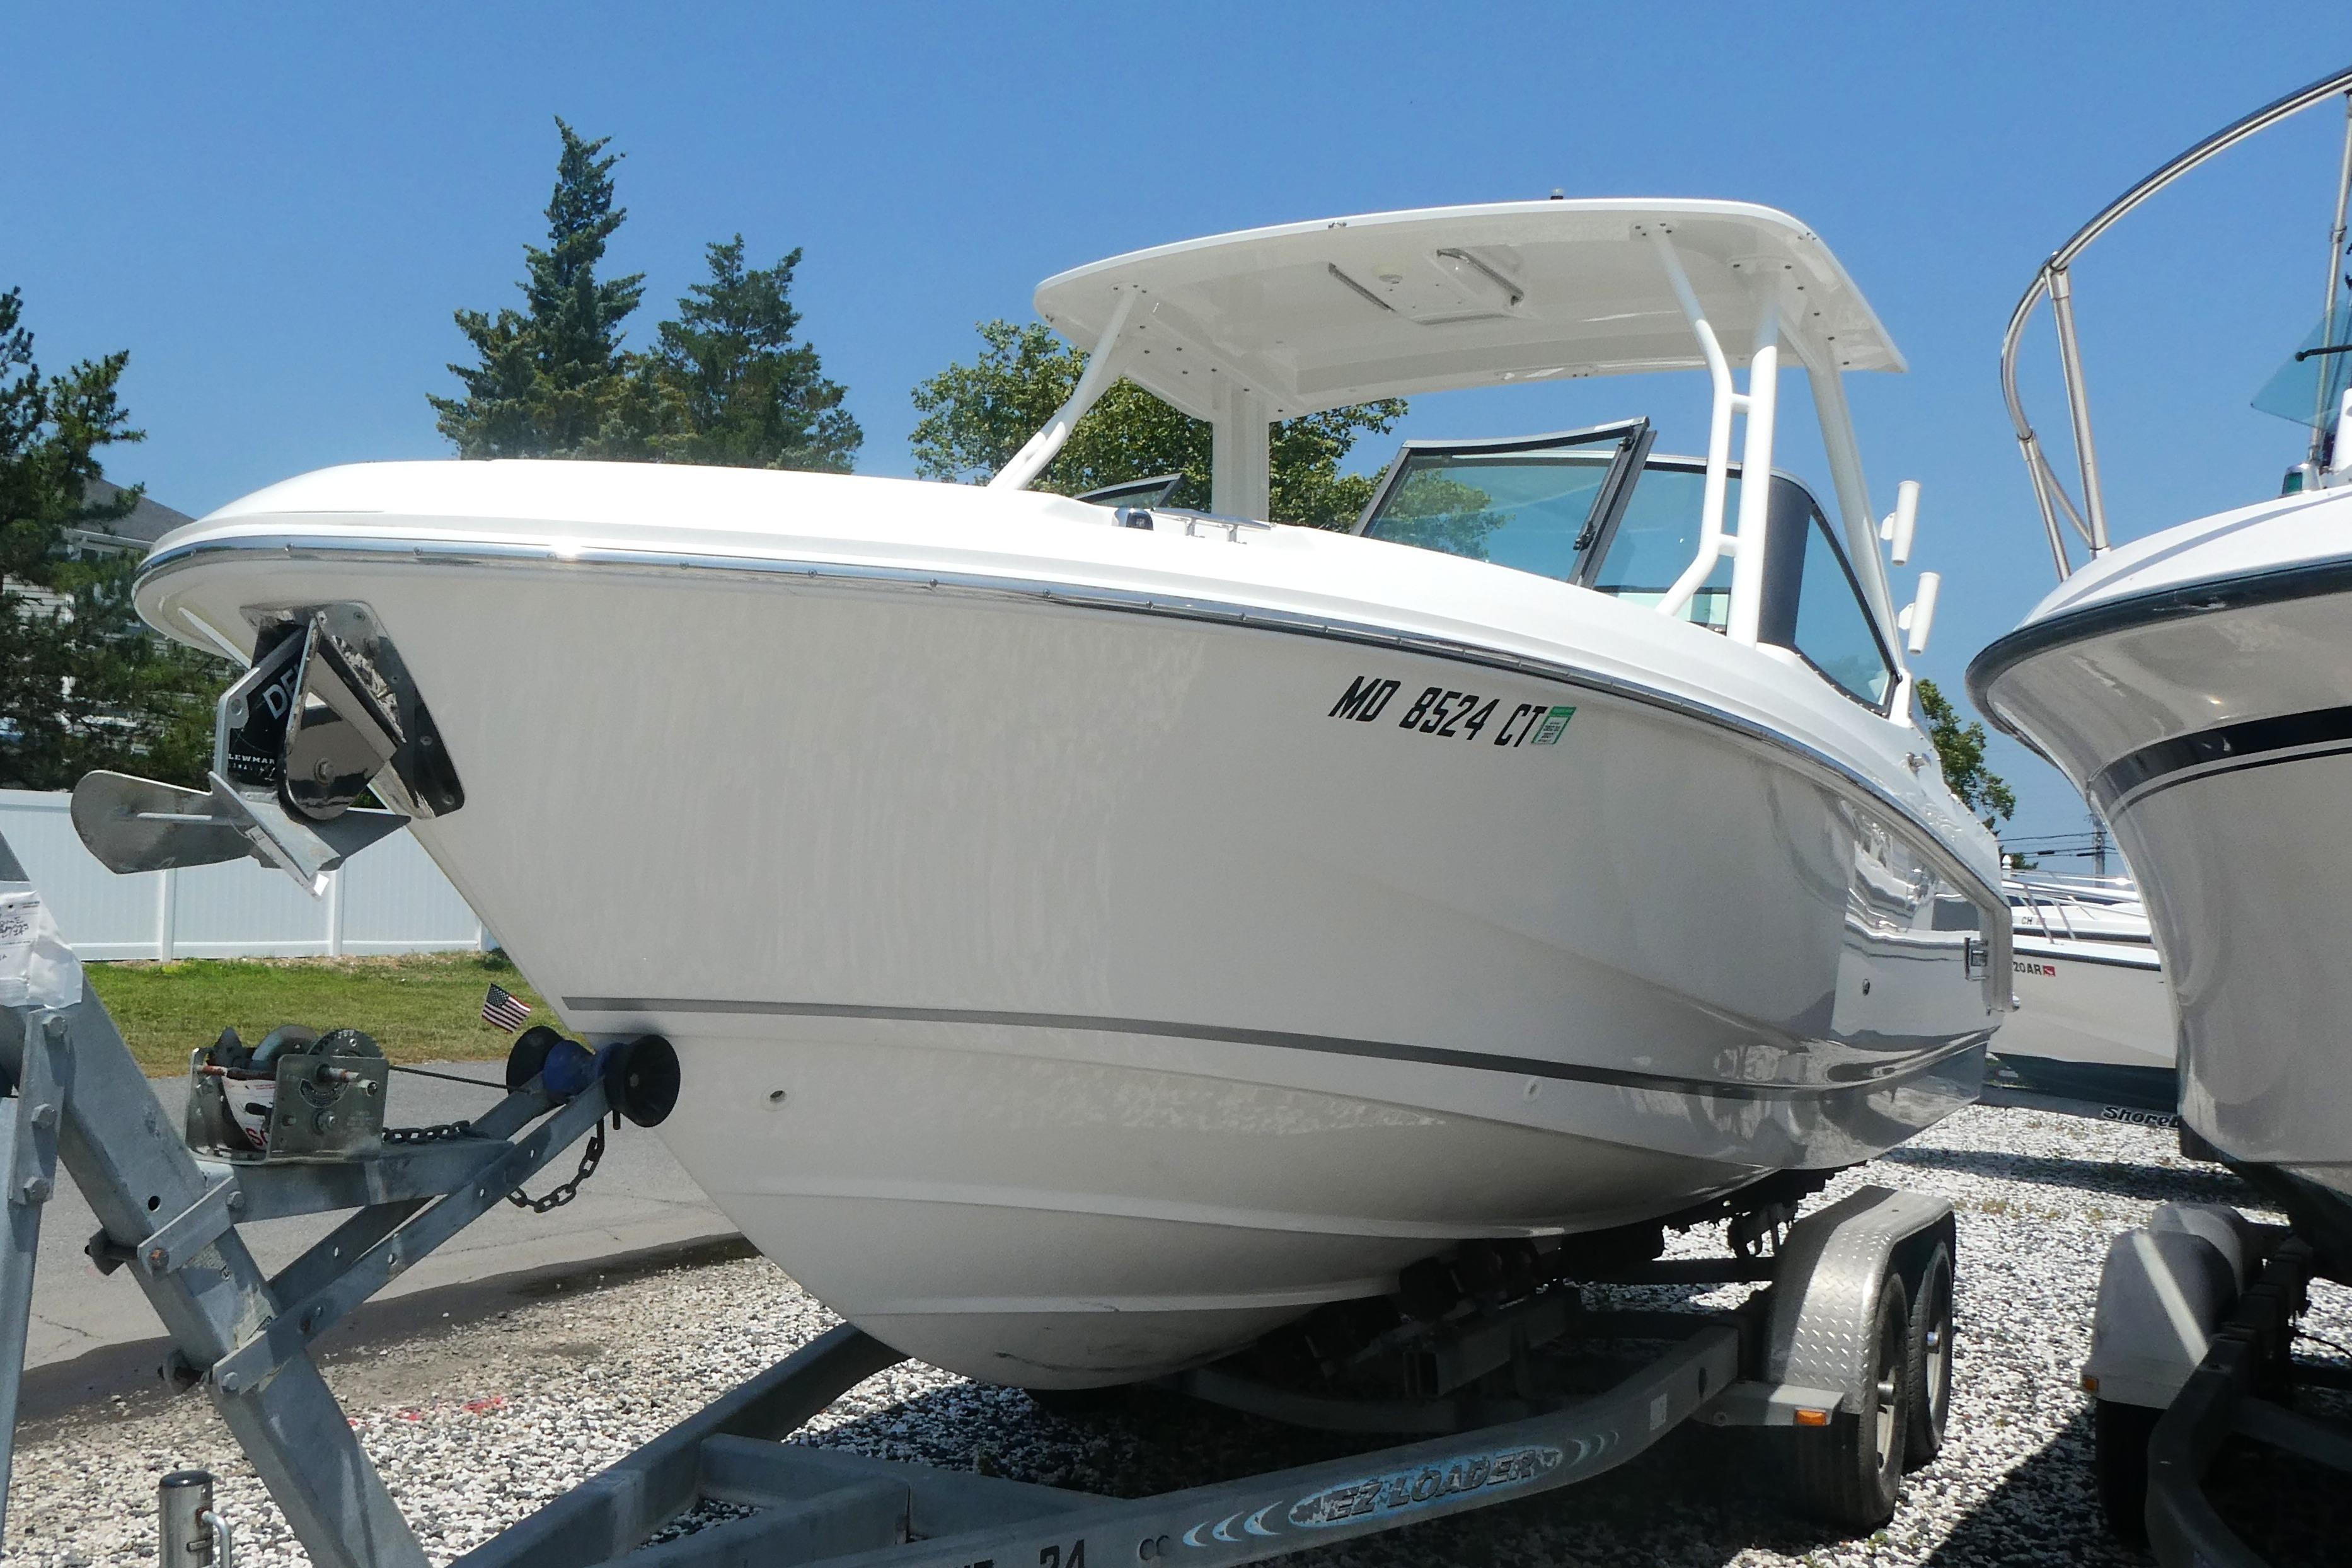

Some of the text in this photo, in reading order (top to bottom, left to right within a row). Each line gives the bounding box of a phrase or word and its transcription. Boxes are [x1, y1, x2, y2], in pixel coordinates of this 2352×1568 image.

[1328, 676, 1401, 722] MD
[1398, 687, 1501, 741] 8524
[1494, 704, 1548, 747] CT
[1388, 1450, 1537, 1507] LOADER
